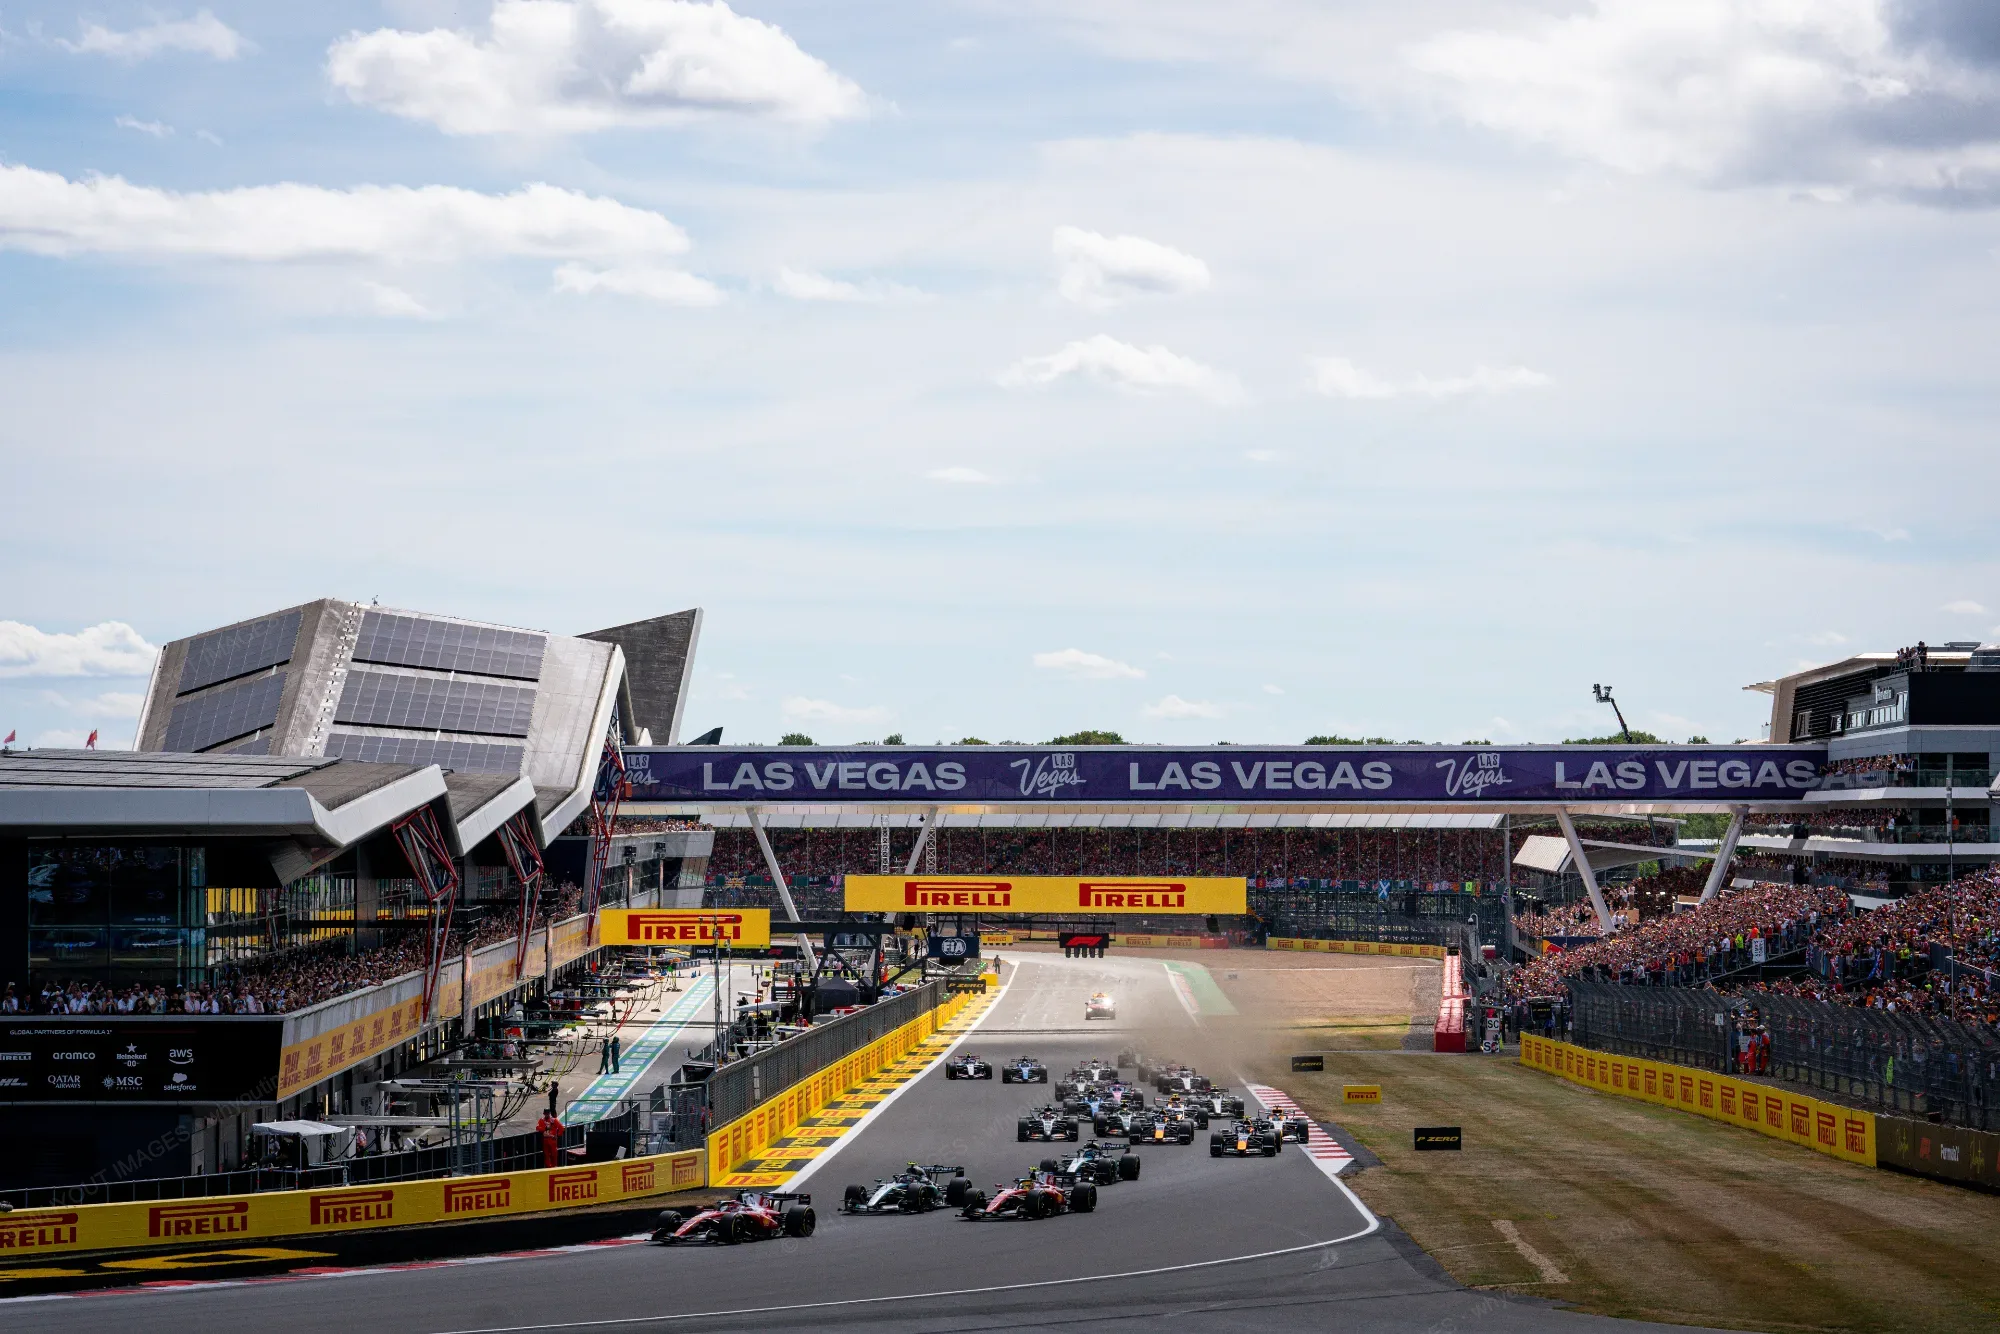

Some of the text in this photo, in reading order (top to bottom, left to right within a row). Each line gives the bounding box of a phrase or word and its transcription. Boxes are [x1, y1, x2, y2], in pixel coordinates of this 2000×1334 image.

[703, 762, 967, 791] LAS VEGAS
[1010, 758, 1087, 798] Vegas
[1130, 761, 1393, 791] LAS VEGAS
[1435, 758, 1512, 798] Vegas
[1556, 760, 1821, 790] LAS VEGAS
[905, 881, 1012, 906] PIRELLI
[1079, 883, 1187, 907] PIRELLI
[628, 914, 742, 940] PIRELLI
[1487, 1020, 1499, 1029] SC
[52, 1052, 96, 1060] aramco
[169, 1048, 193, 1058] aws
[0, 1078, 24, 1086] HL
[47, 1075, 81, 1084] QATAR
[116, 1077, 143, 1086] MSC
[163, 1083, 197, 1092] salesforce
[1347, 1091, 1378, 1099] PIRELLI
[1766, 1096, 1783, 1129] PIRELLI
[1791, 1103, 1810, 1137] PIRELLI
[1817, 1111, 1837, 1146] PIRELLI
[1845, 1118, 1865, 1154] PIRELLI
[622, 1162, 655, 1193] PIRELLI
[672, 1156, 697, 1185] PIRELLI
[444, 1179, 510, 1213] PIRELLI
[548, 1170, 598, 1202] PIRELLI
[149, 1202, 249, 1237] PIRELLI
[310, 1190, 394, 1225] PIRELLI
